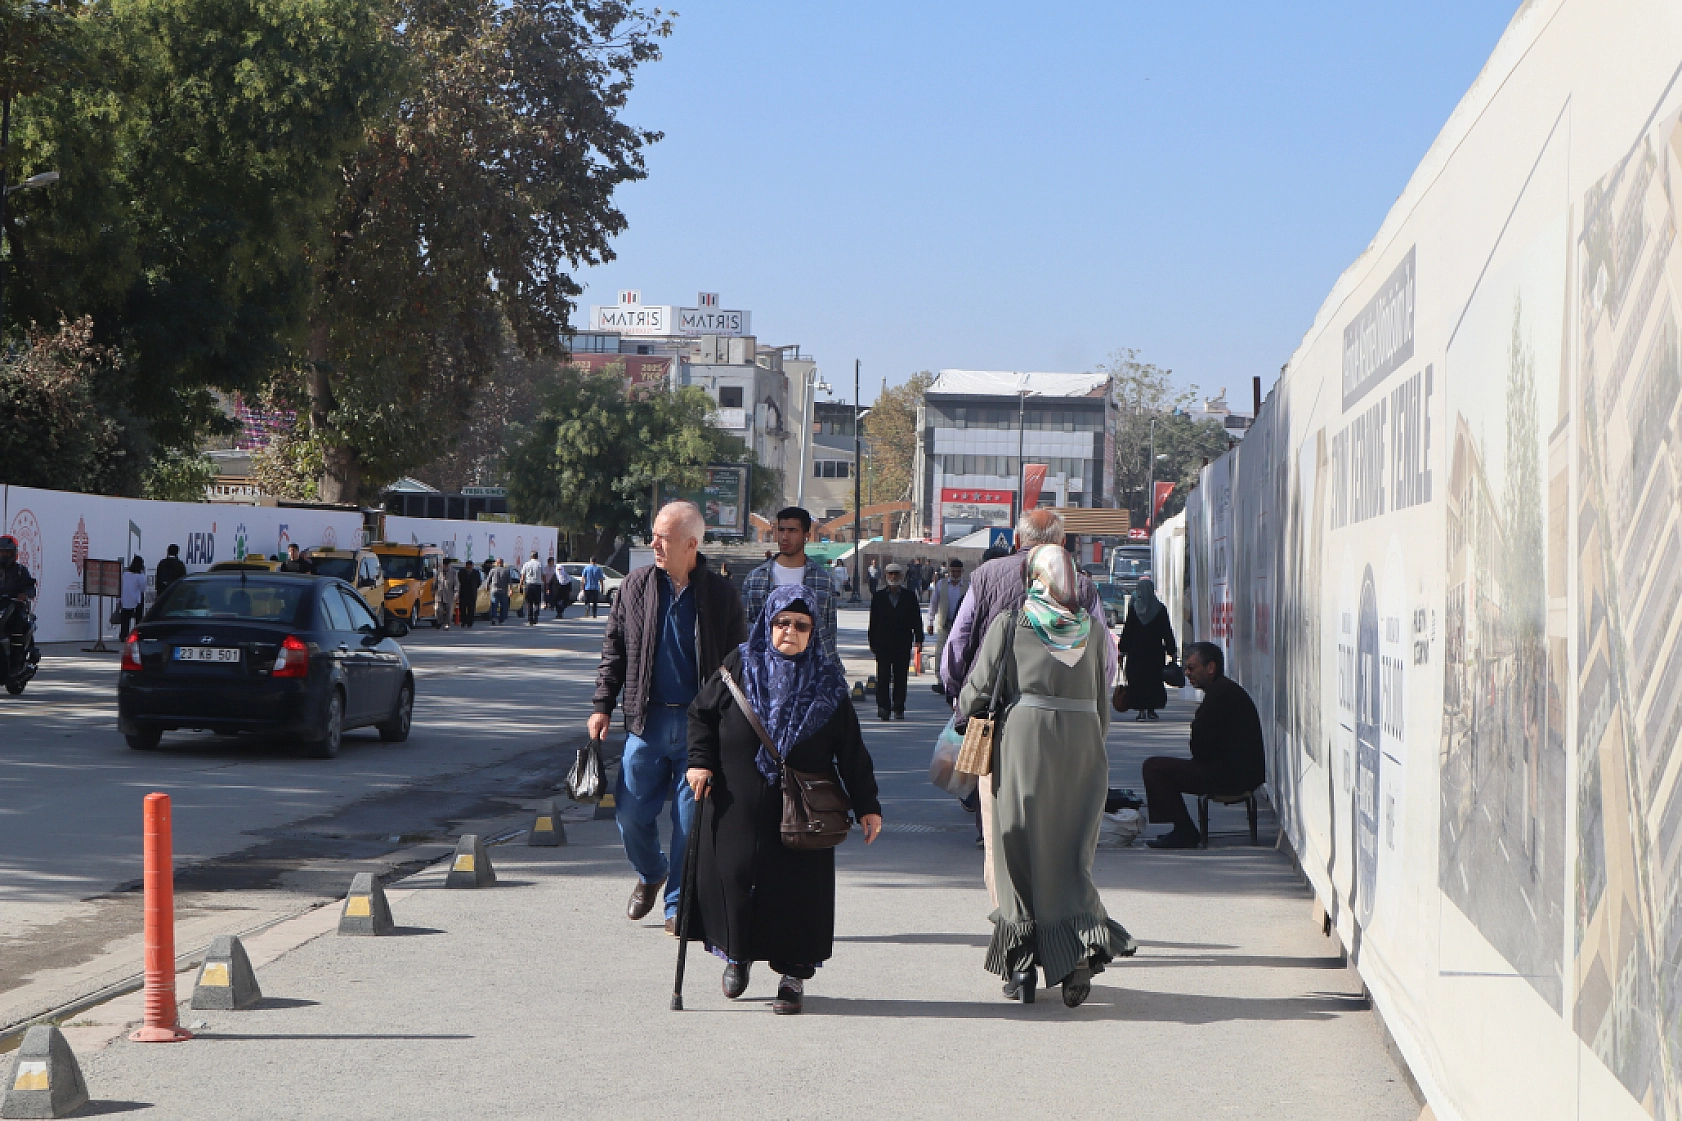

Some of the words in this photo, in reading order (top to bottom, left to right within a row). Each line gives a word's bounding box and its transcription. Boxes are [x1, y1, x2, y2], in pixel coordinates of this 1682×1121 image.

[1390, 362, 1434, 512] YENİLE
[186, 532, 215, 564] AFAD
[180, 648, 193, 659] 23
[218, 650, 238, 661] 501
